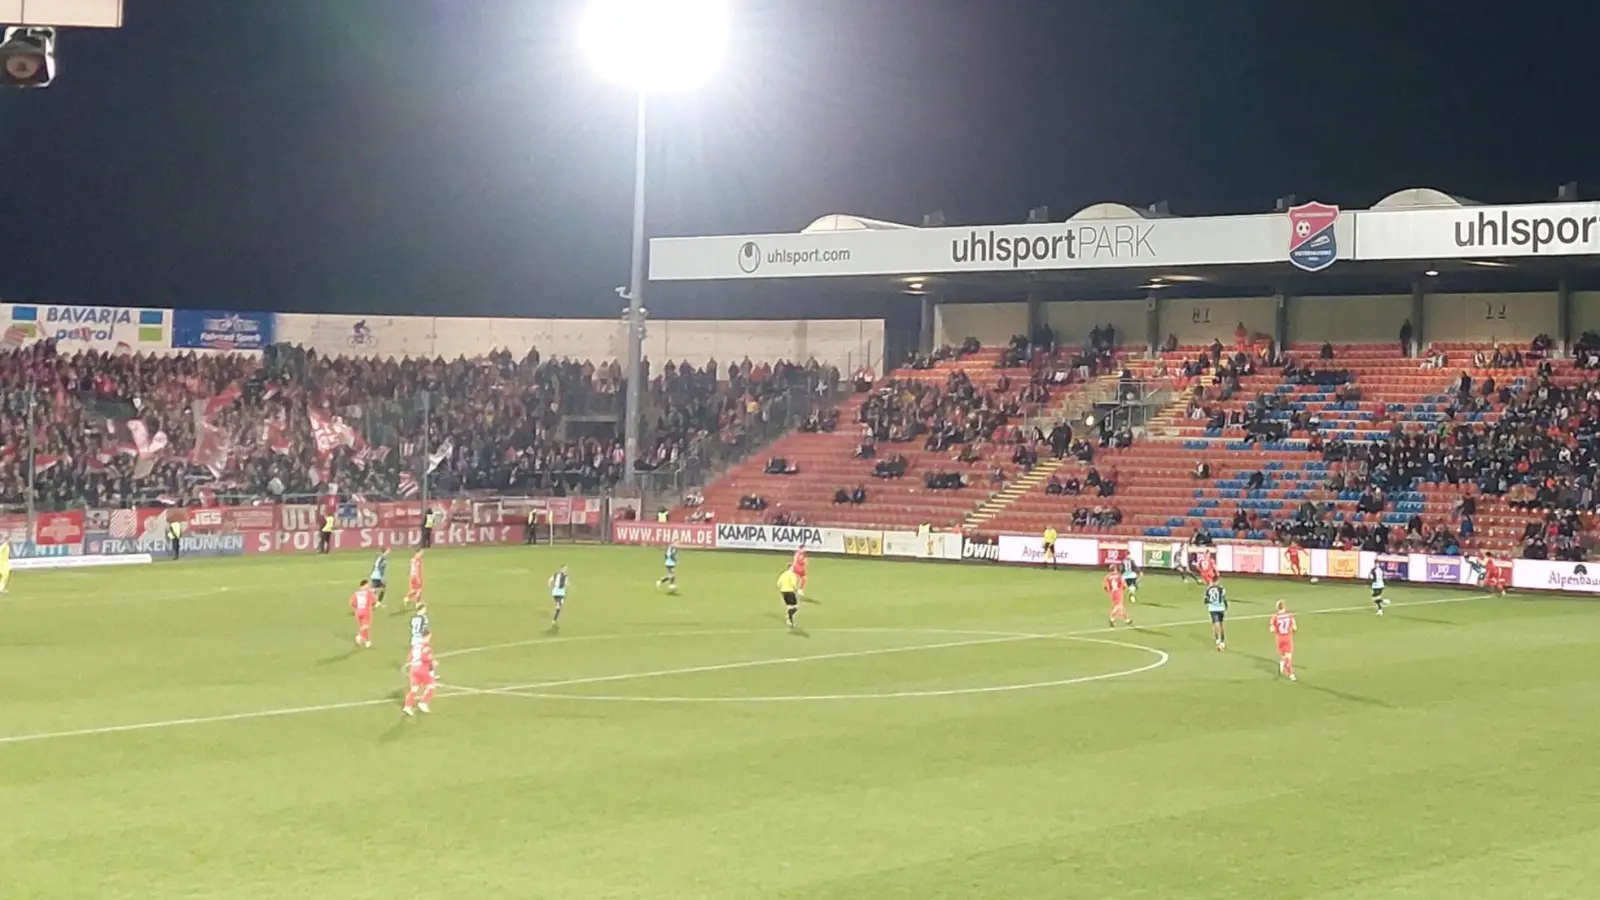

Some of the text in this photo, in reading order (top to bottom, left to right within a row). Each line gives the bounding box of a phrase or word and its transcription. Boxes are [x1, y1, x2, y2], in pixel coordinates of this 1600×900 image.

[1455, 210, 1600, 252] uhlspor
[952, 224, 1156, 267] uhlsportPARK
[767, 248, 850, 266] uhlsport.com
[46, 307, 131, 324] BAVARIA
[616, 526, 713, 545] WWW.FHAM.DE
[718, 524, 822, 545] KAMPA KAMPA
[963, 537, 999, 559] bwin
[1548, 570, 1600, 587] Alpenbau
[1278, 618, 1291, 634] 27
